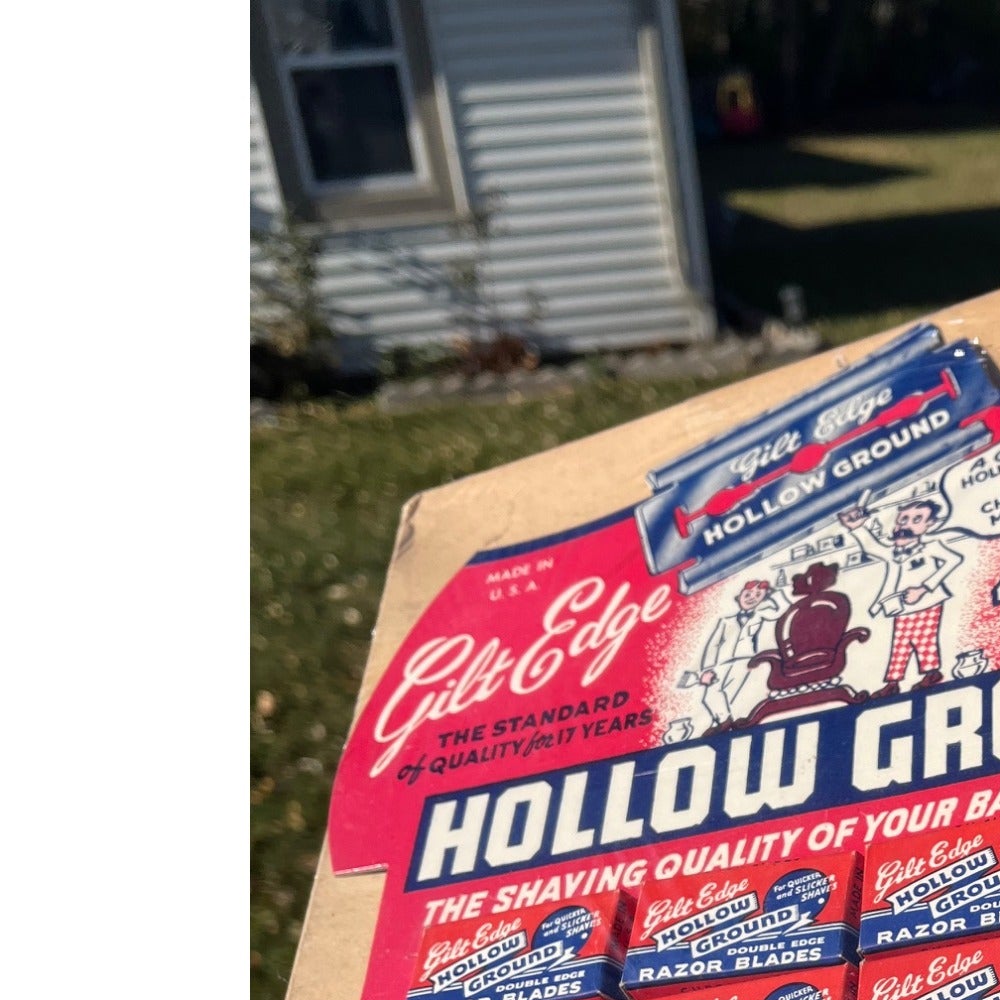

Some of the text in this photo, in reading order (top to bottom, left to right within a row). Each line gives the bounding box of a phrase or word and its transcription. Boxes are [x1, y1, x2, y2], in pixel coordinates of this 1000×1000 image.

[730, 387, 892, 482] Gilt Edge
[703, 410, 949, 545] HOLLOW GROUND
[970, 457, 986, 472] A
[485, 557, 554, 584] MADE IN
[370, 576, 672, 778] Gilt Edge
[438, 691, 630, 749] THE STANDARD
[397, 753, 425, 786] of
[429, 739, 525, 775] QUALITY
[524, 730, 554, 758] for
[582, 708, 653, 738] YEARS
[416, 721, 818, 882] HOLLOW
[423, 897, 488, 928] THE
[493, 860, 648, 916] SHAVING
[654, 826, 802, 880] QUALITY
[807, 817, 860, 852] OF
[864, 795, 963, 844] YOUR
[773, 871, 821, 893] For QUICKER
[640, 877, 750, 941] Gilt Edge
[775, 873, 836, 900] and SLICKER
[800, 881, 839, 903] SHAVES
[661, 898, 750, 945] HOLLOW
[697, 910, 792, 954] GROUND
[637, 947, 822, 981] RAZOR BLADES
[726, 936, 826, 956] DOUBLE EDGE
